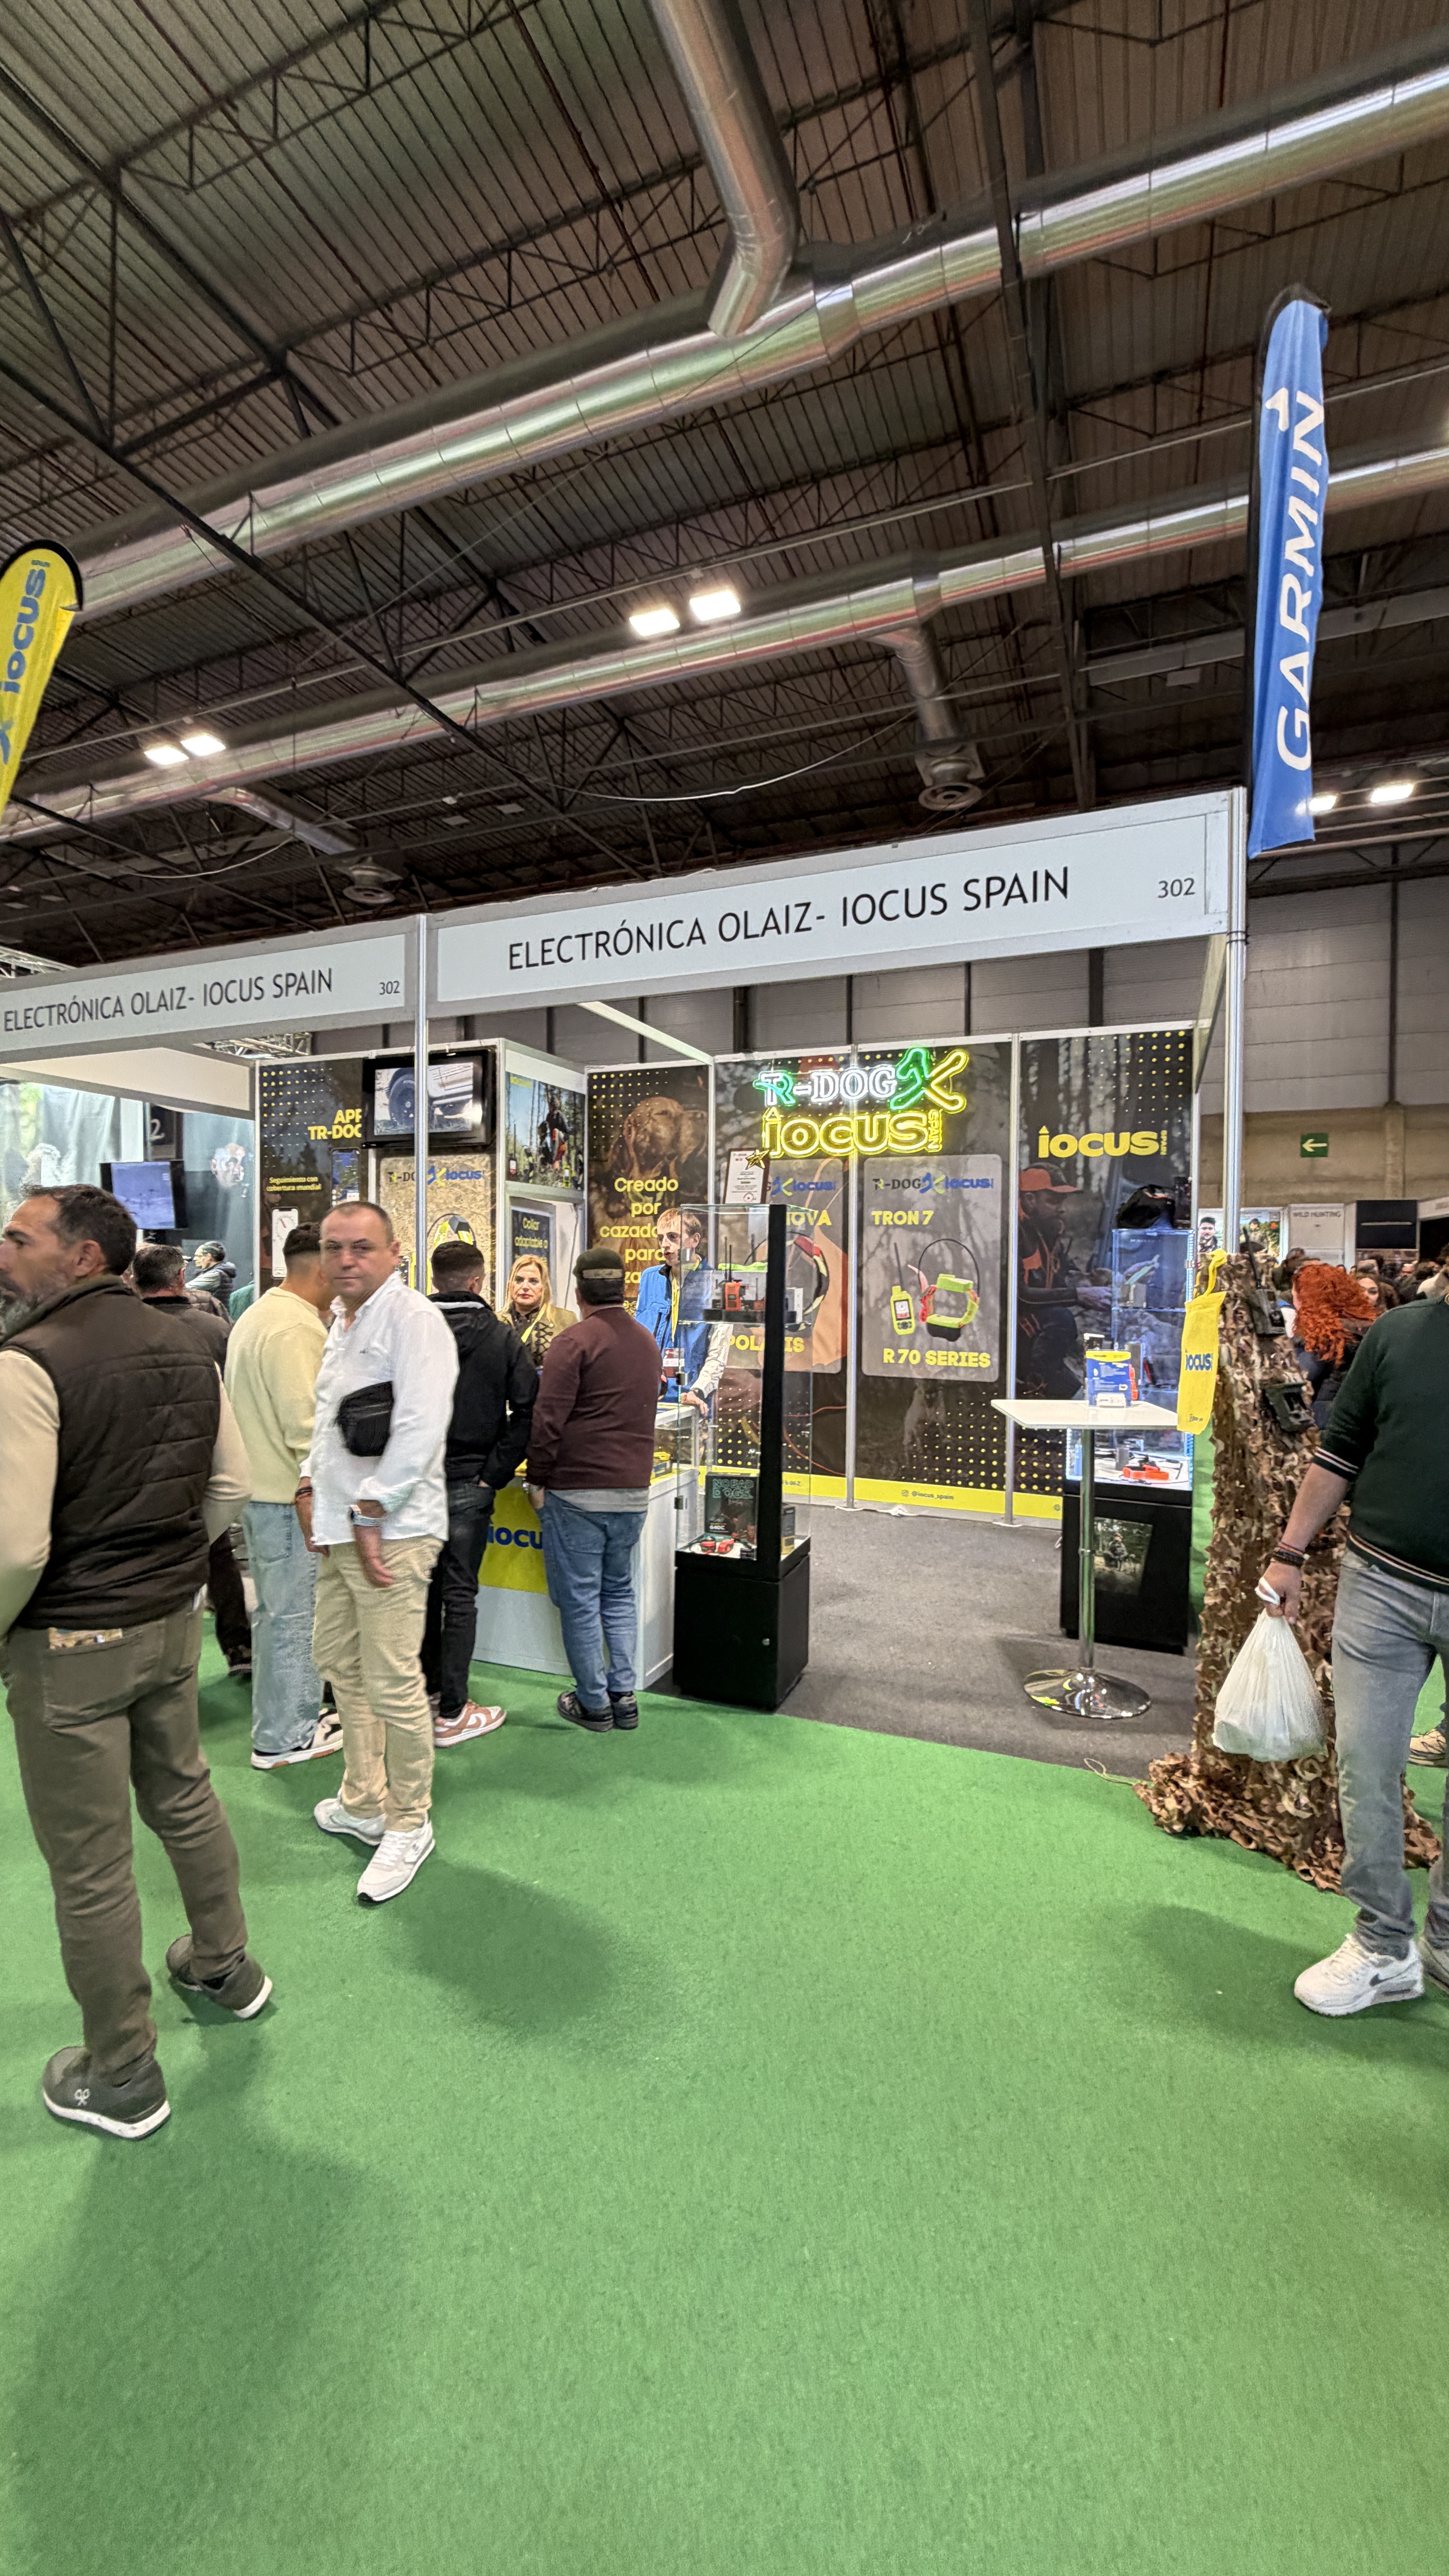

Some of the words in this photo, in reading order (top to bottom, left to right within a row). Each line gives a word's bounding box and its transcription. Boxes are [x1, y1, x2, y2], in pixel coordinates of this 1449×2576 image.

[1277, 390, 1324, 771] GARMIN
[1158, 878, 1195, 898] 302
[509, 917, 706, 970] ELECTRÓNICA
[718, 902, 825, 942] OLAIZ-
[842, 883, 948, 927] IOCUS
[963, 866, 1068, 911] SPAIN
[379, 980, 400, 995] 302
[4, 995, 125, 1032] ELECTRÓNICA
[131, 987, 194, 1015] OLAIZ-
[204, 976, 264, 1006] IOCUS
[273, 968, 331, 998] SPAIN
[928, 1109, 940, 1150] SPAIN
[614, 1176, 679, 1192] Creado
[631, 1202, 662, 1218] por
[871, 1210, 919, 1225] TRON
[922, 1210, 934, 1225] 7
[625, 1248, 667, 1263] para
[883, 1348, 895, 1363] R
[897, 1349, 921, 1365] 70
[925, 1350, 991, 1368] SERIES
[486, 1526, 543, 1550] iocu
